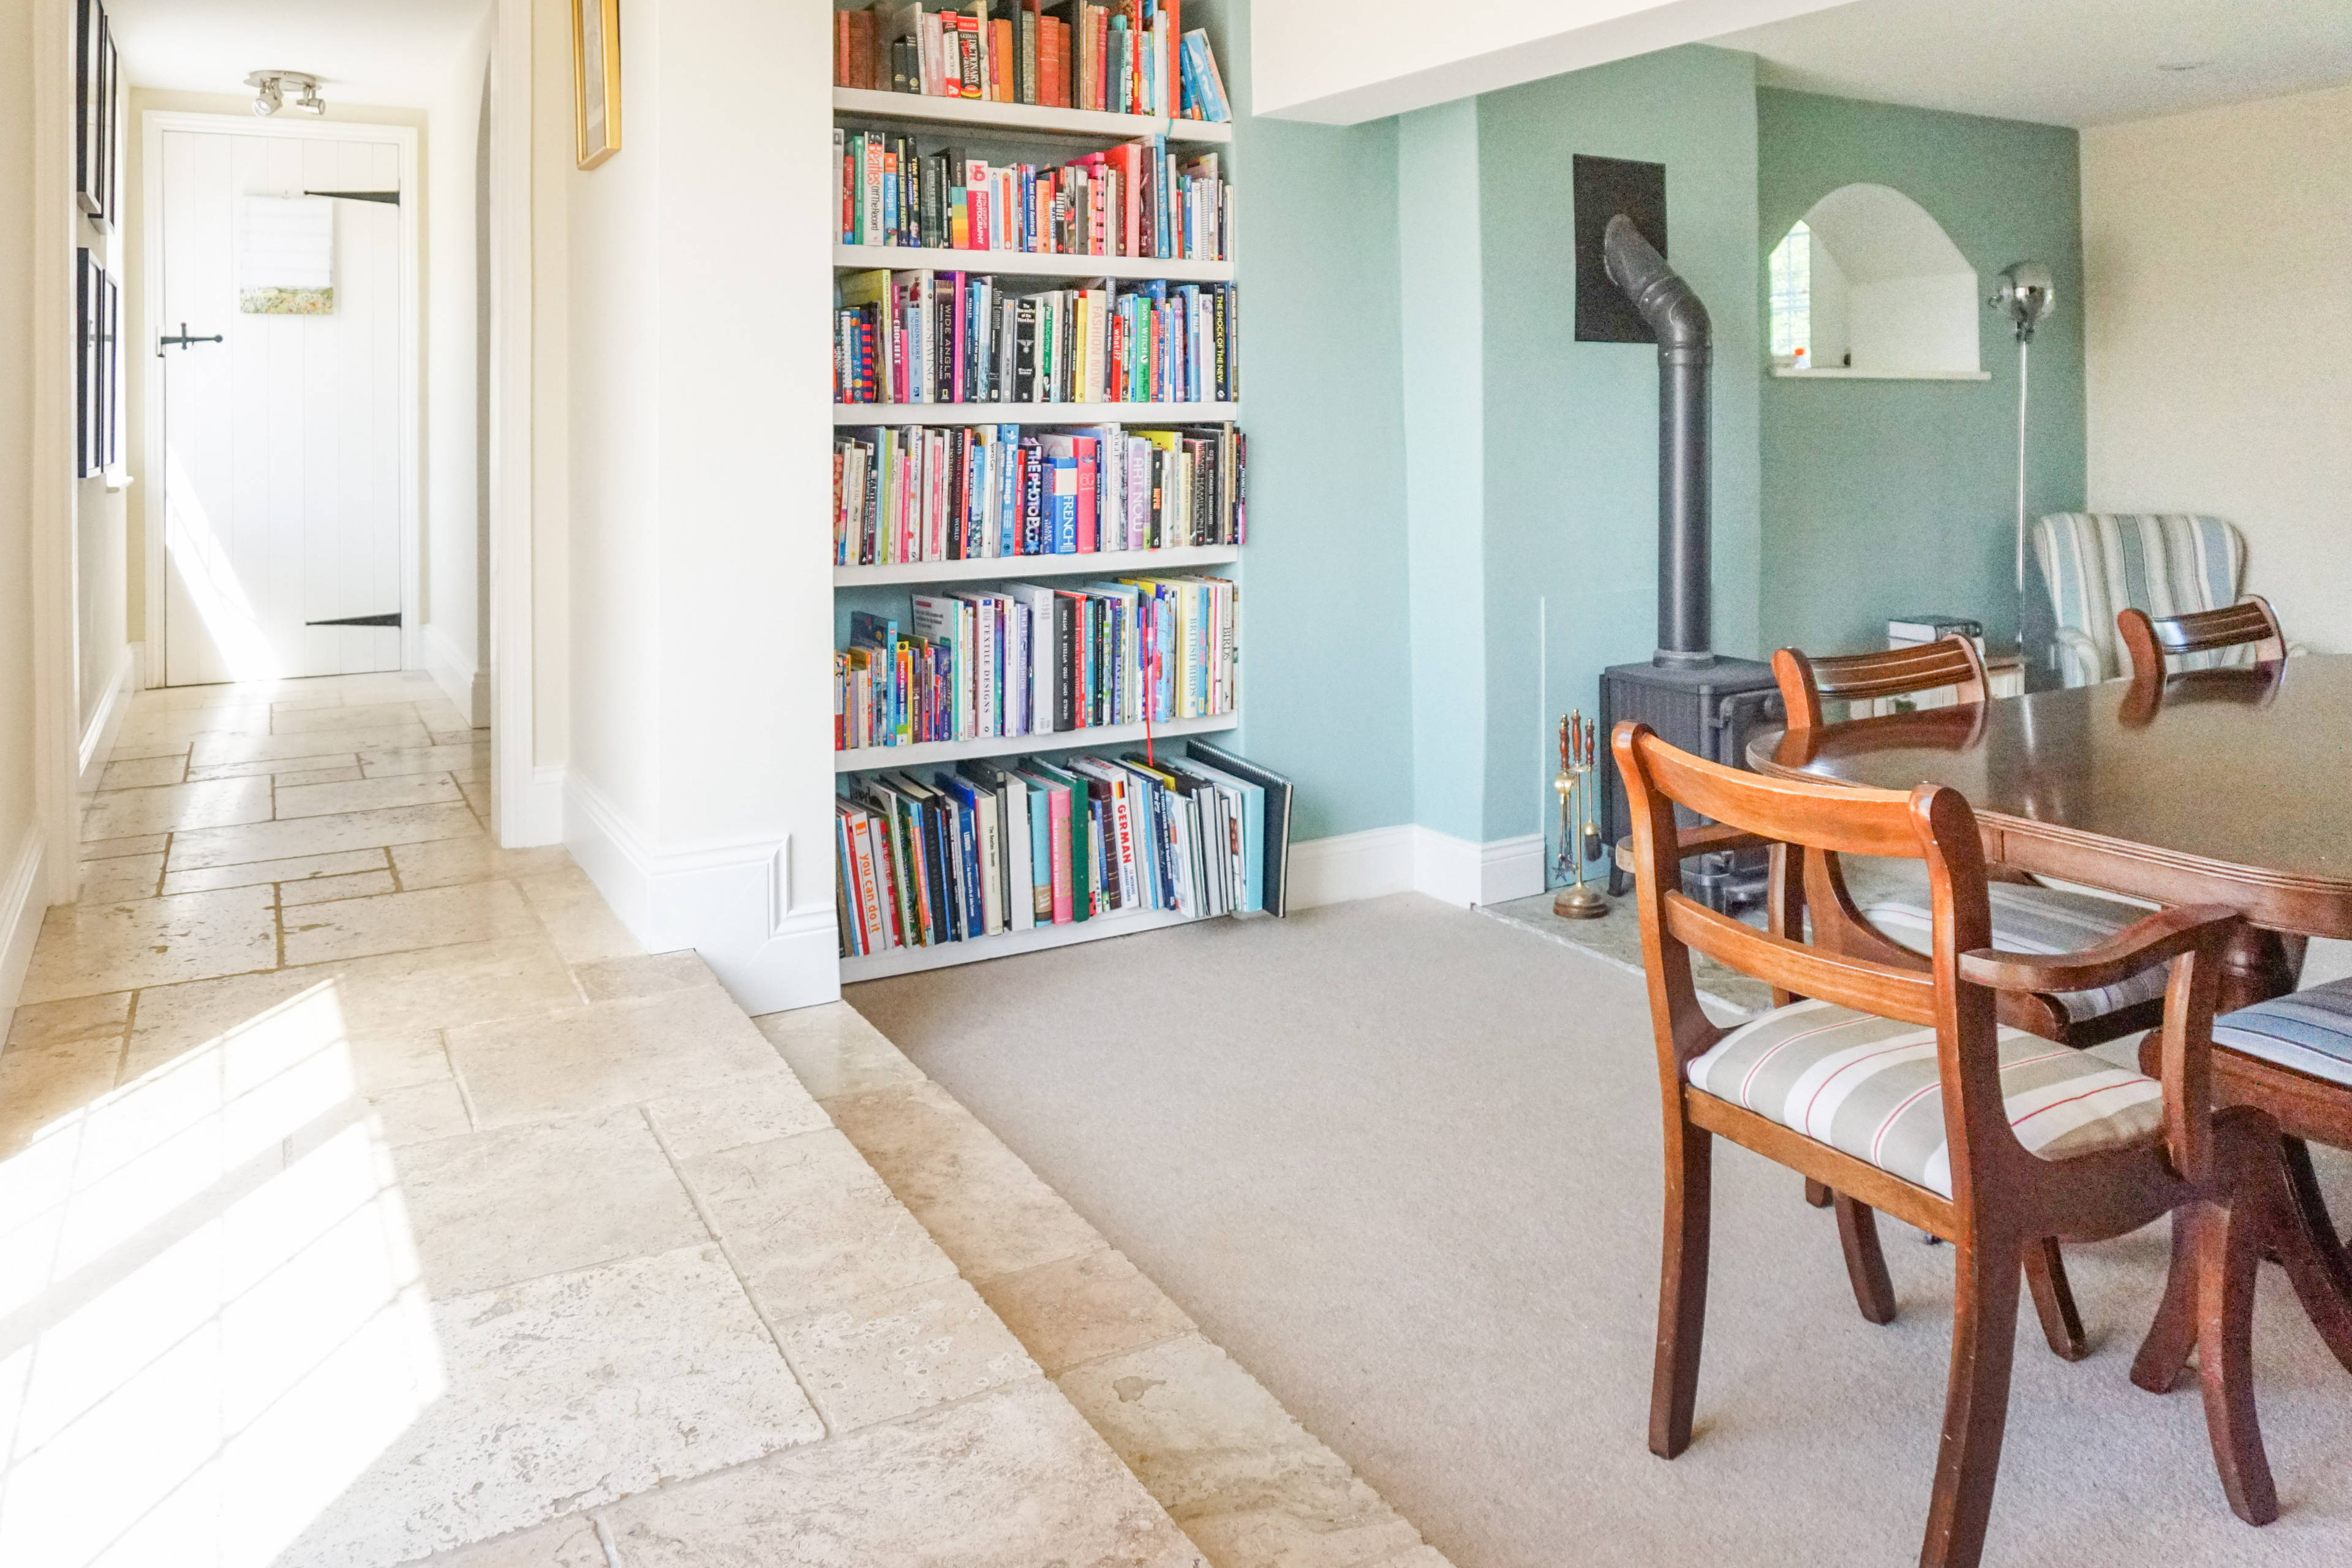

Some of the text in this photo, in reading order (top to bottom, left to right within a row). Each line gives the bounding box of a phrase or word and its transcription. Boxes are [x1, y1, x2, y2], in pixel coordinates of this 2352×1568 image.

[968, 39, 979, 85] DICTIONARY
[867, 145, 883, 186] Beatles
[870, 186, 880, 230] Off The Record
[992, 288, 1003, 330] John Lennon
[926, 333, 935, 381] SEWING
[1090, 306, 1103, 388] FASHION NOW
[1216, 338, 1224, 348] OF
[1003, 443, 1017, 505] Beatles songs
[1025, 446, 1041, 554] THE PHOTO BOOK
[1132, 458, 1144, 532] ART NOW
[1196, 446, 1205, 528] LEWIS HAMILTON
[1063, 496, 1074, 546] FRENCH
[1189, 618, 1197, 696] BRITISH BIRDS
[1223, 627, 1231, 661] BIRDS
[1117, 804, 1132, 864] GERMAN
[859, 853, 881, 932] you can do it
